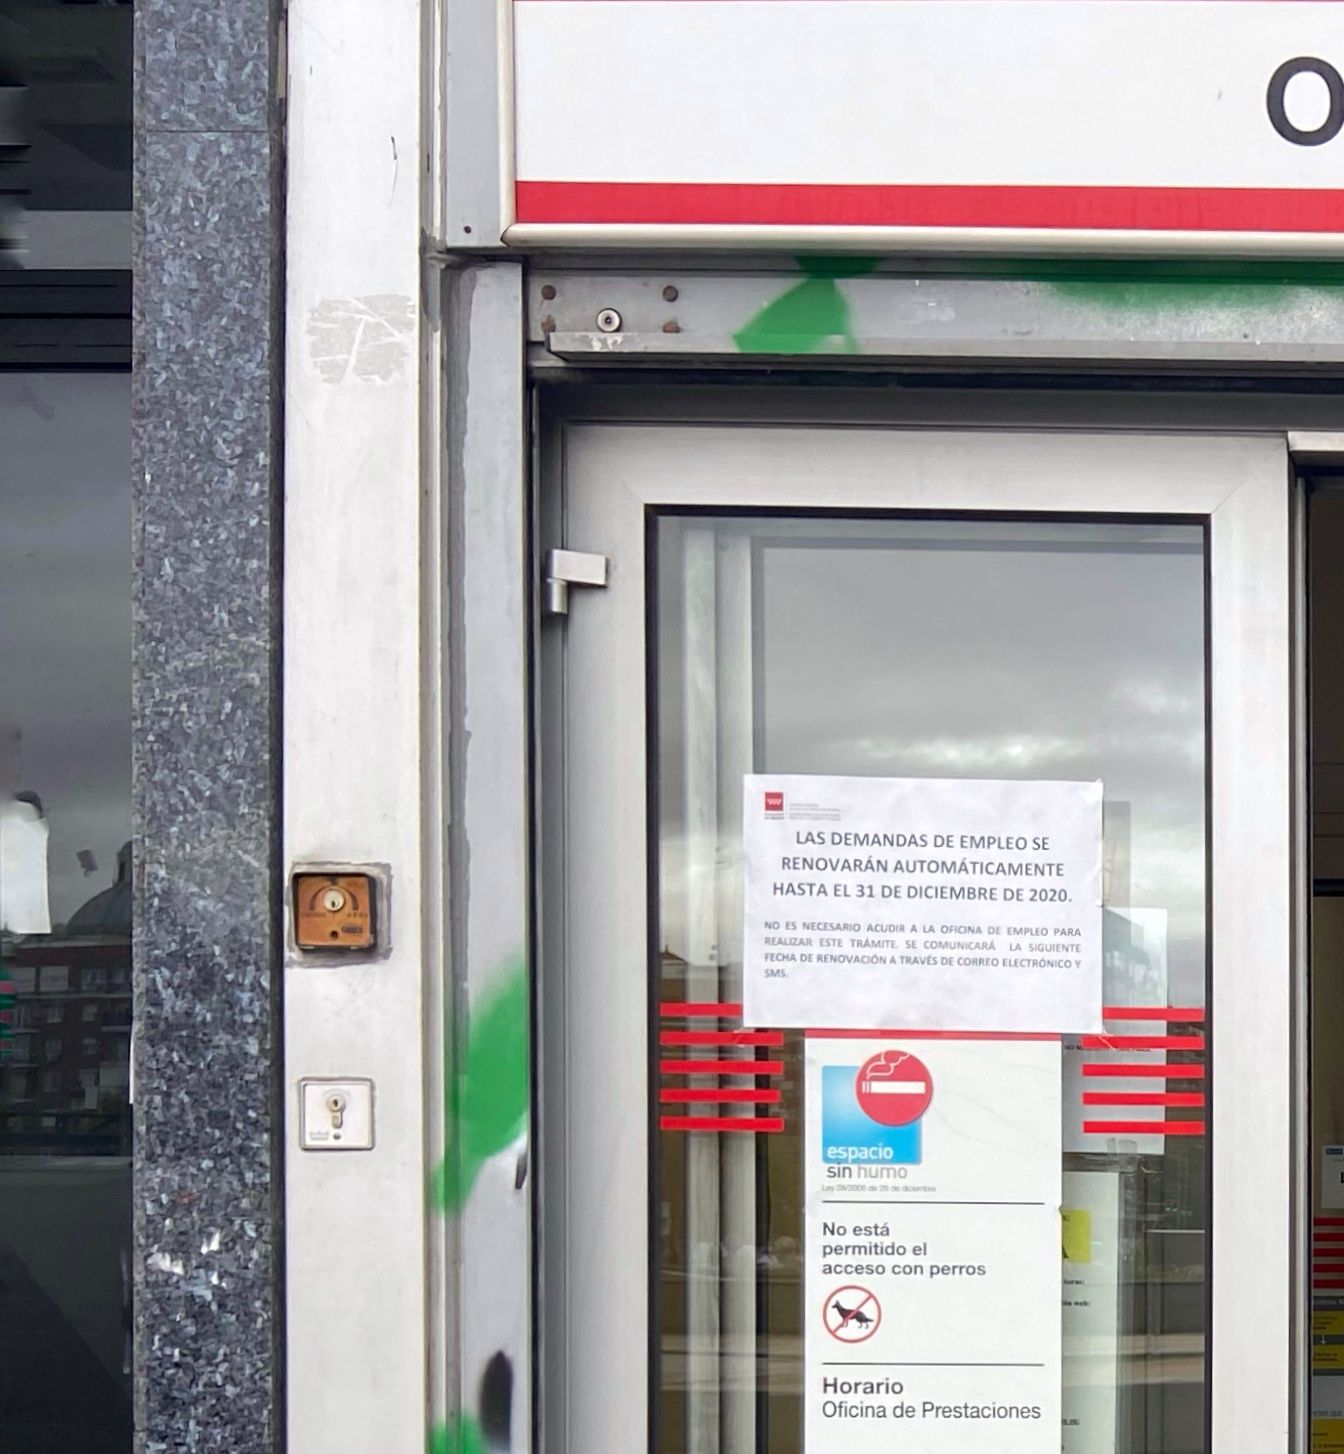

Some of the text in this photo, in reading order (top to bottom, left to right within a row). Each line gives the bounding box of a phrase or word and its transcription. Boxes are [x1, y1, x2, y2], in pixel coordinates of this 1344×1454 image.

[796, 831, 1049, 850] LAS DEMANDAS DE EMPLEO SE
[781, 853, 1064, 877] RENOVARÁN AUTOMÁTICAMENTE
[772, 882, 1072, 902] HASTA EL 31 DE DICIEMBRE DE 2020.
[827, 1144, 893, 1161] espacio
[826, 1163, 907, 1178] sin humo
[822, 1222, 889, 1236] No está
[822, 1241, 926, 1258] permitido el
[822, 1263, 986, 1278] acceso con perros
[823, 1377, 903, 1394] Horario
[822, 1400, 1041, 1418] Oficina de Prestaciones
